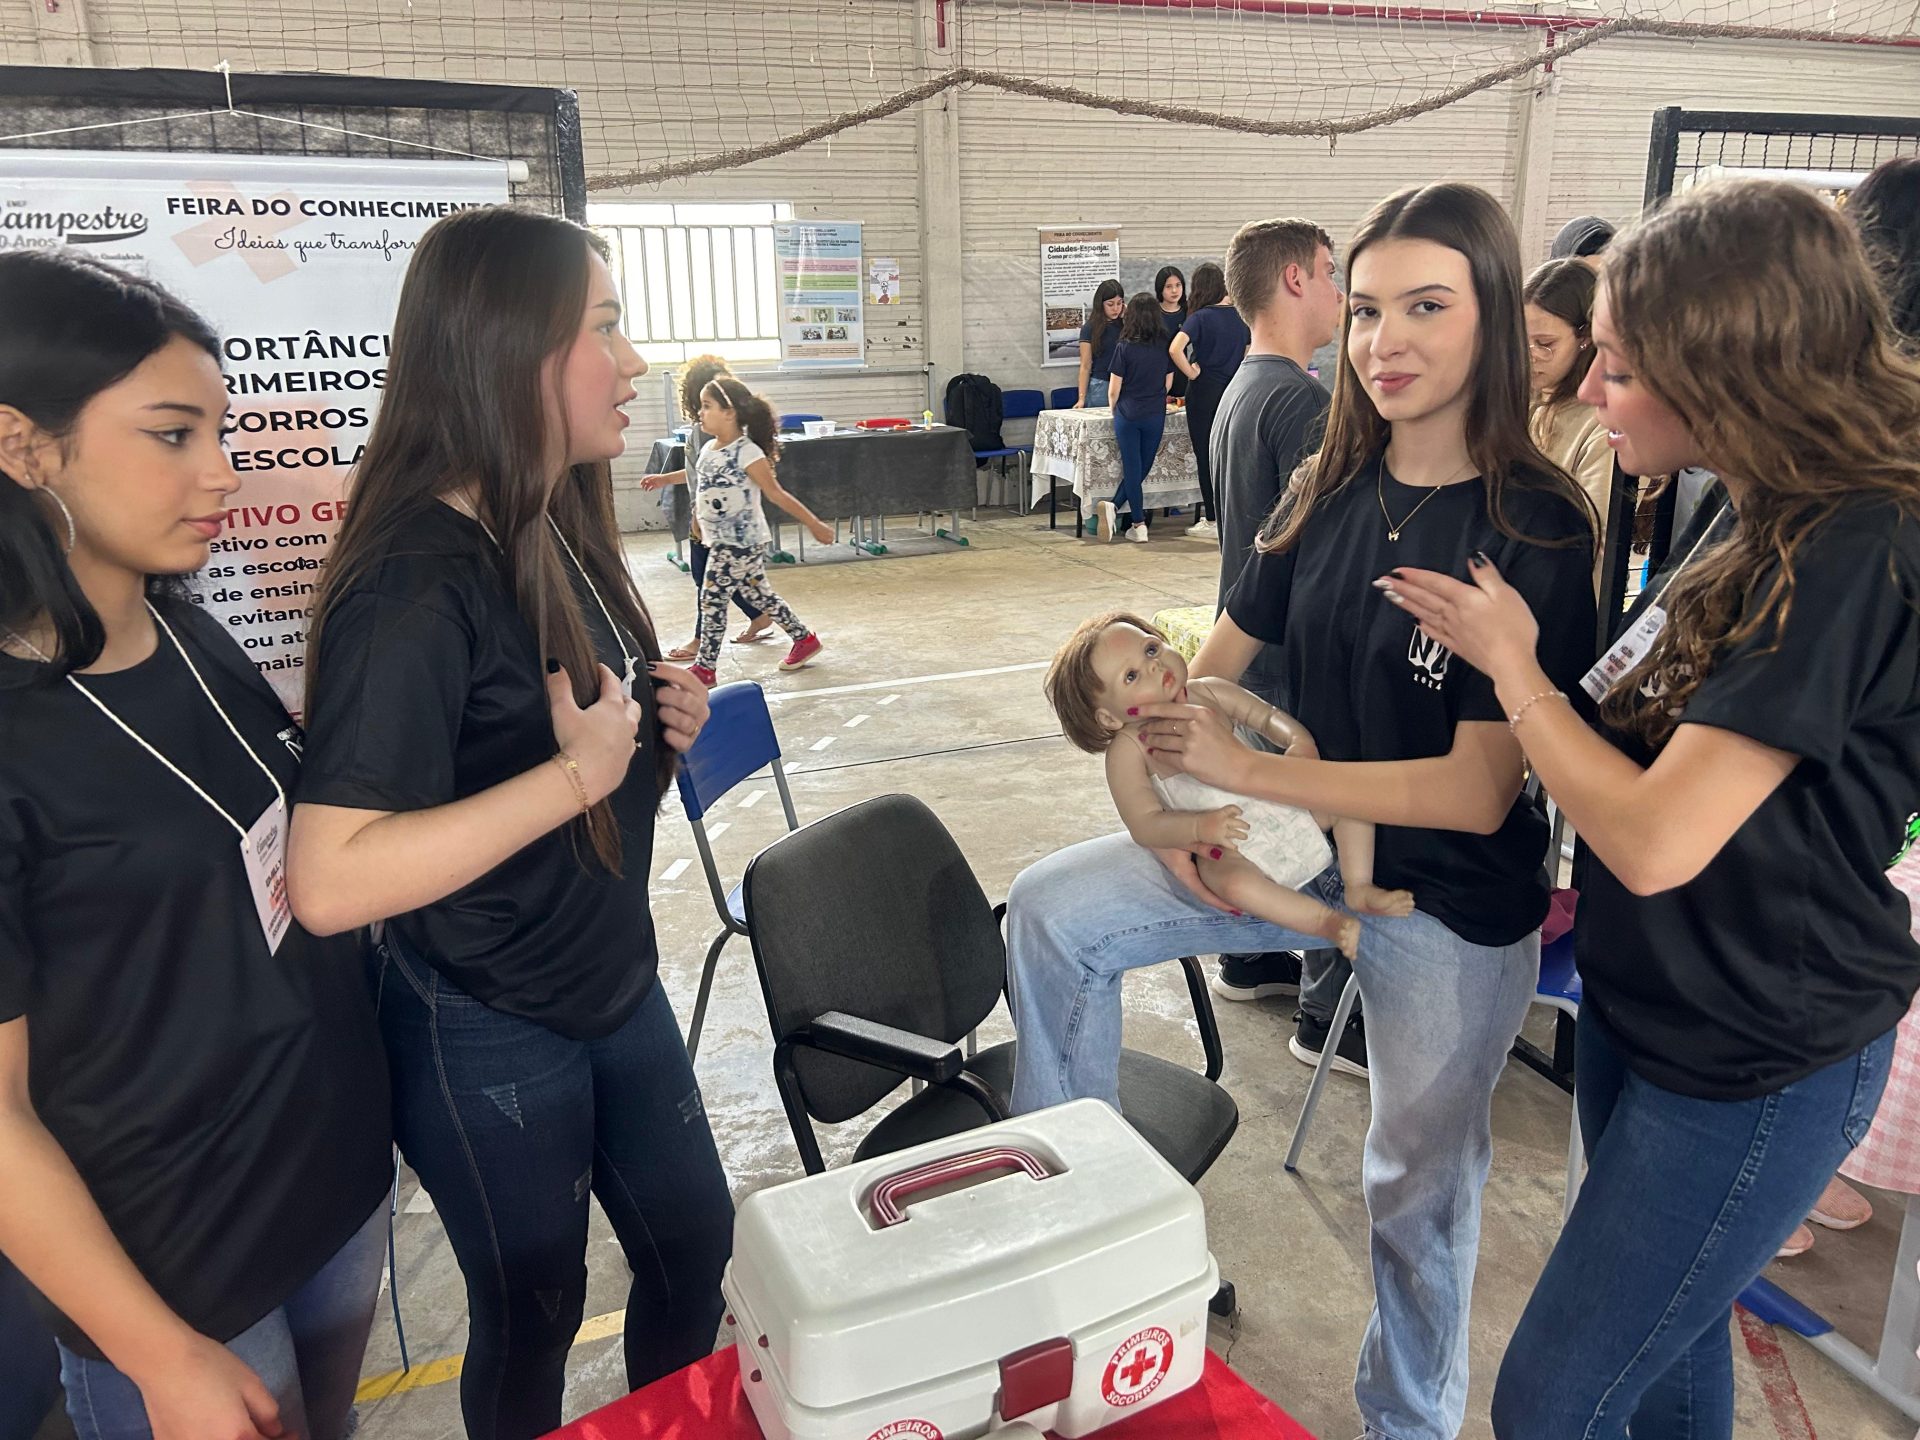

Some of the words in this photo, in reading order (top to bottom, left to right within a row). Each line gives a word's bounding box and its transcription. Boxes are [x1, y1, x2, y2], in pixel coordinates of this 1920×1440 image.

[167, 197, 245, 216] FEIRA
[252, 199, 291, 217] DO
[299, 199, 497, 218] CONHECIMEN
[0, 205, 143, 237] ampestre
[214, 226, 289, 250] Ideias
[293, 241, 328, 263] que
[275, 533, 328, 548] com
[208, 565, 236, 579] as
[212, 588, 244, 603] de
[243, 635, 275, 649] ou
[1110, 1328, 1171, 1366] PRIMEIROS
[1105, 1370, 1166, 1406] SOCORROS
